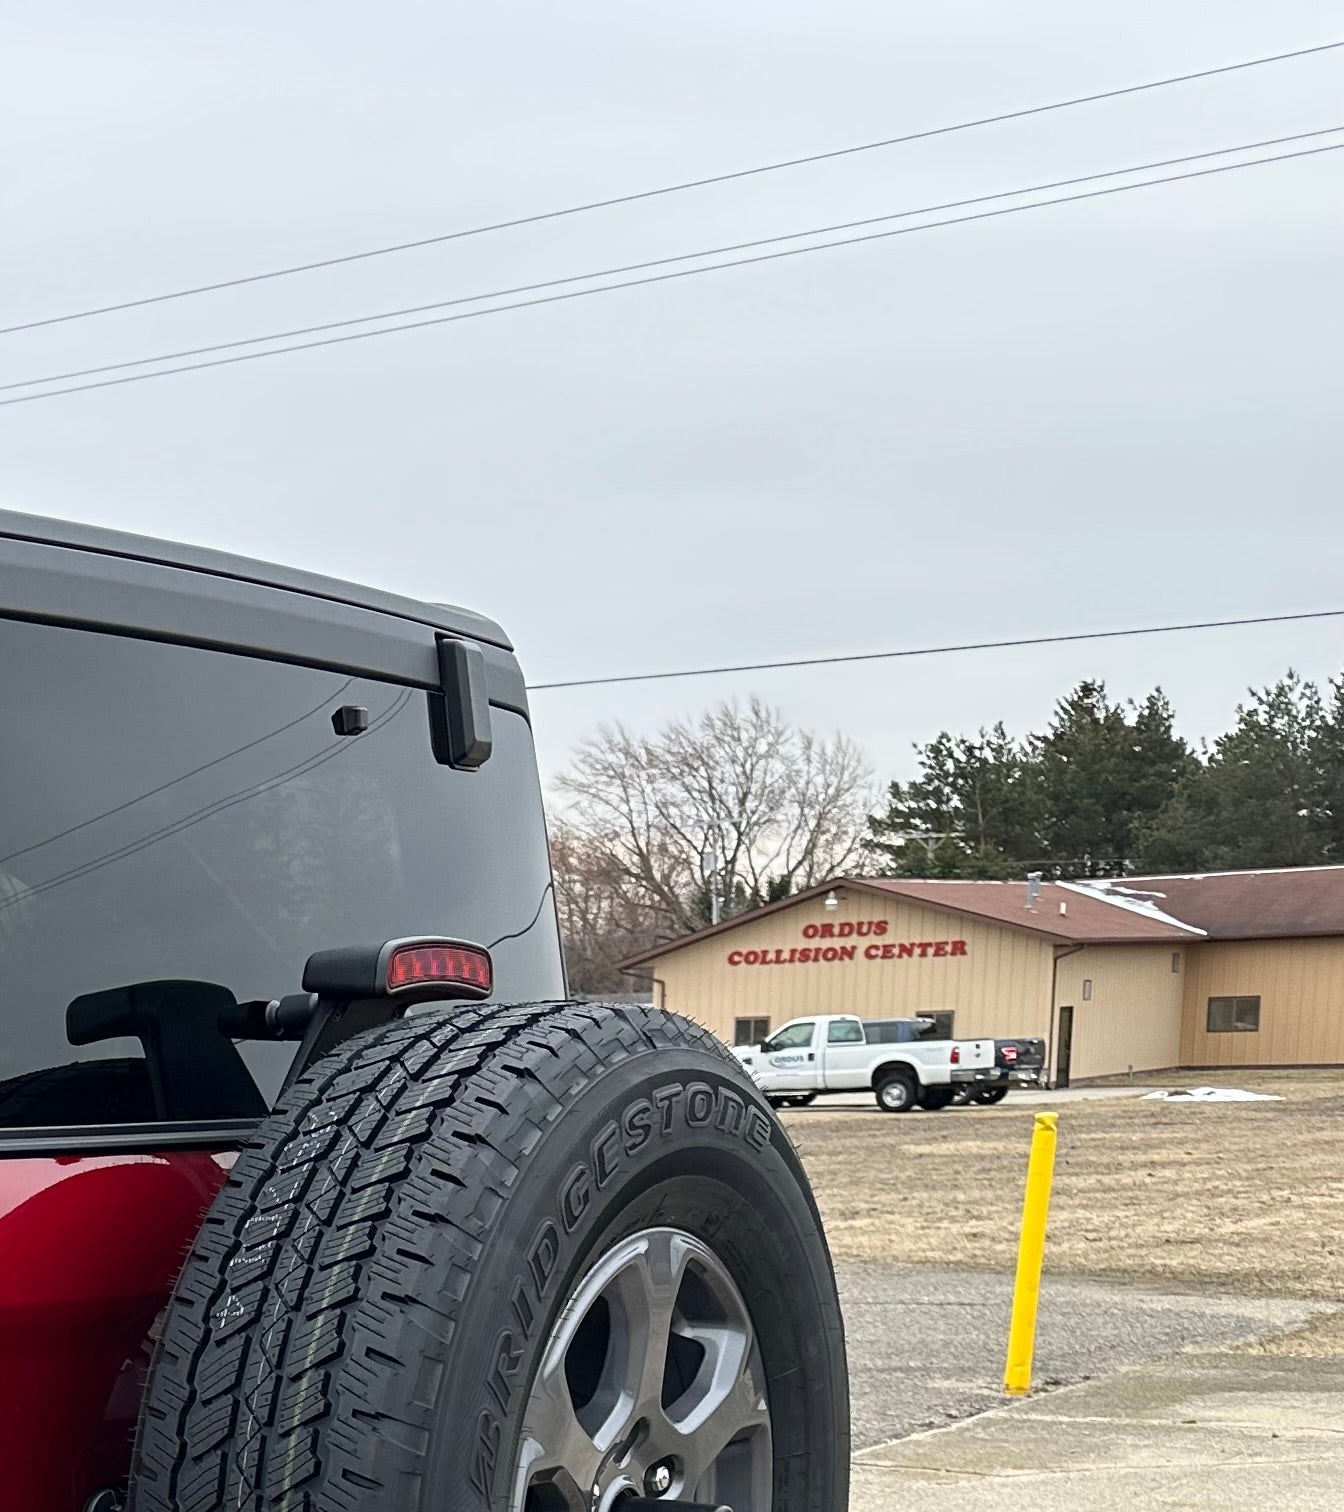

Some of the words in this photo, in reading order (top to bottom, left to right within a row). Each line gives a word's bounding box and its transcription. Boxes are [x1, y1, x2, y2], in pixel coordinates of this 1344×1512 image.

[802, 920, 889, 939] ORDUS
[727, 945, 858, 966] COLLISION
[864, 940, 968, 960] CENTER
[468, 1081, 772, 1510] BRIDGESTONE
